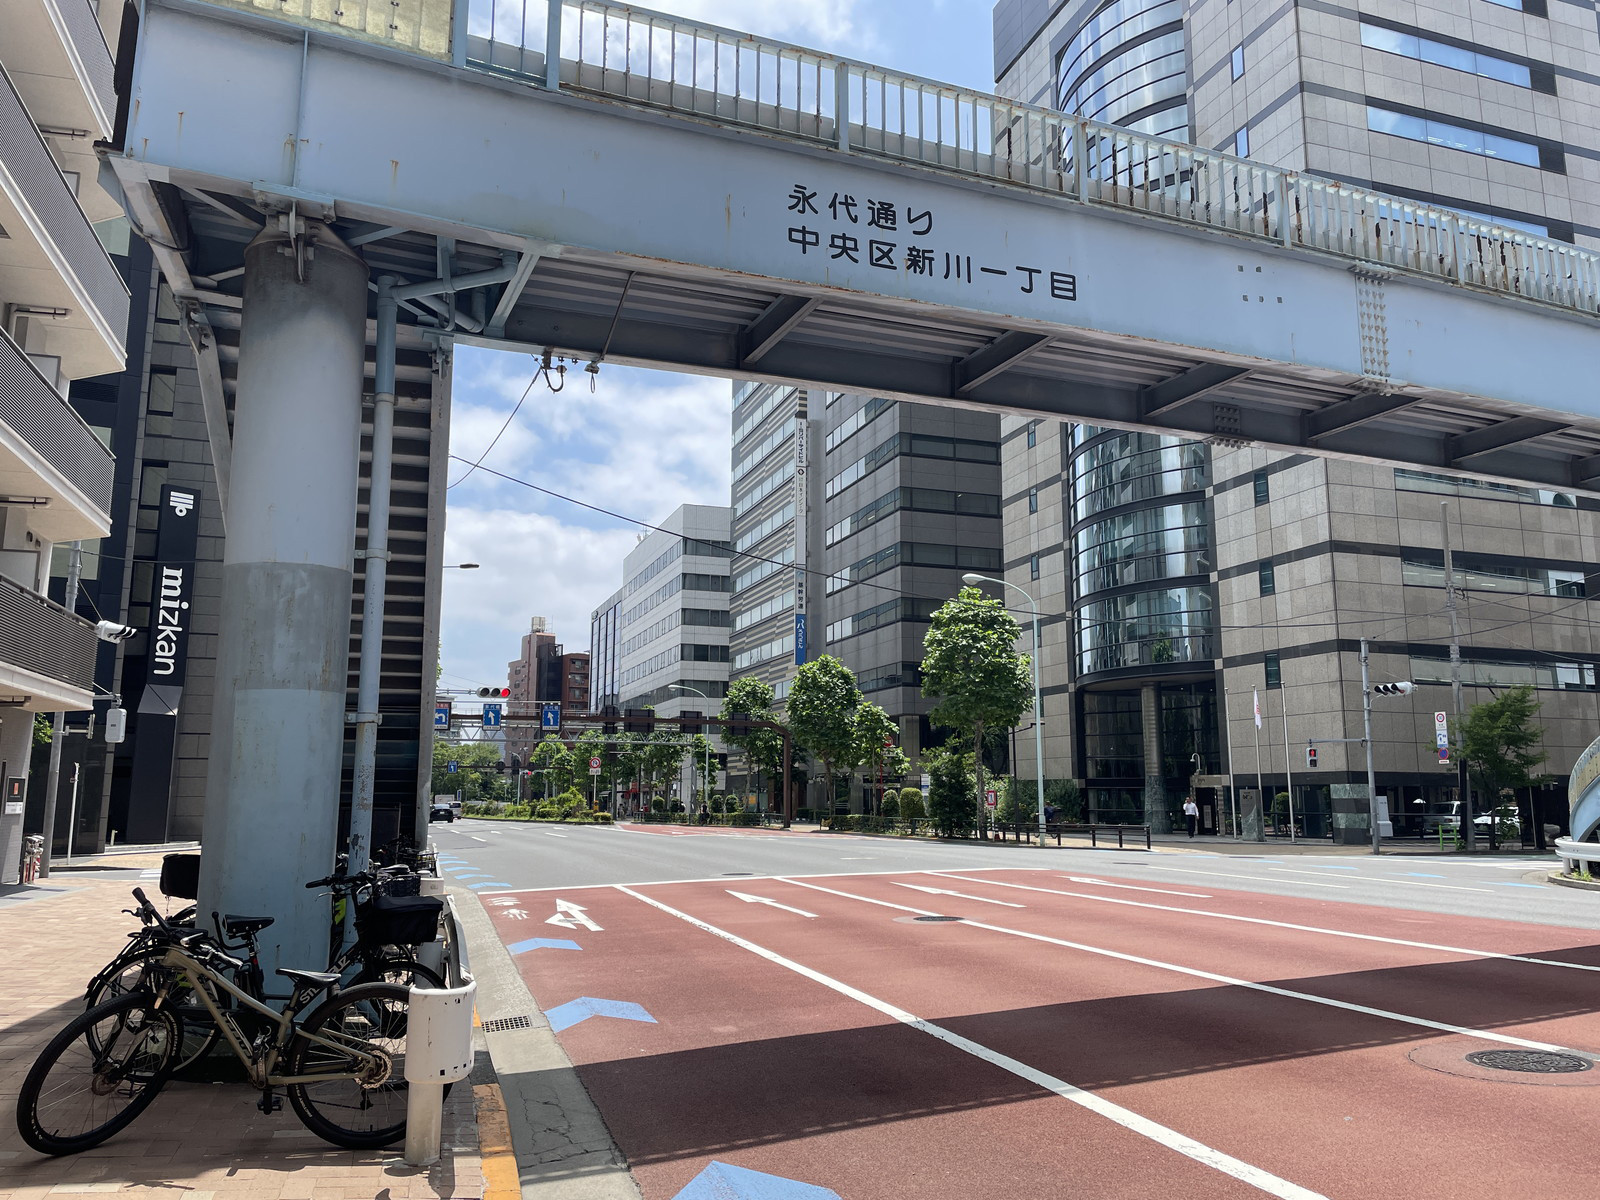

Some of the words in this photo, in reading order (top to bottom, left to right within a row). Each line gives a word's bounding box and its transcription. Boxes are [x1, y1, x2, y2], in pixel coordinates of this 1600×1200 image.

[787, 183, 933, 236] 永代通り
[787, 225, 1077, 302] 中央区新川一丁目
[153, 566, 190, 676] mizkan
